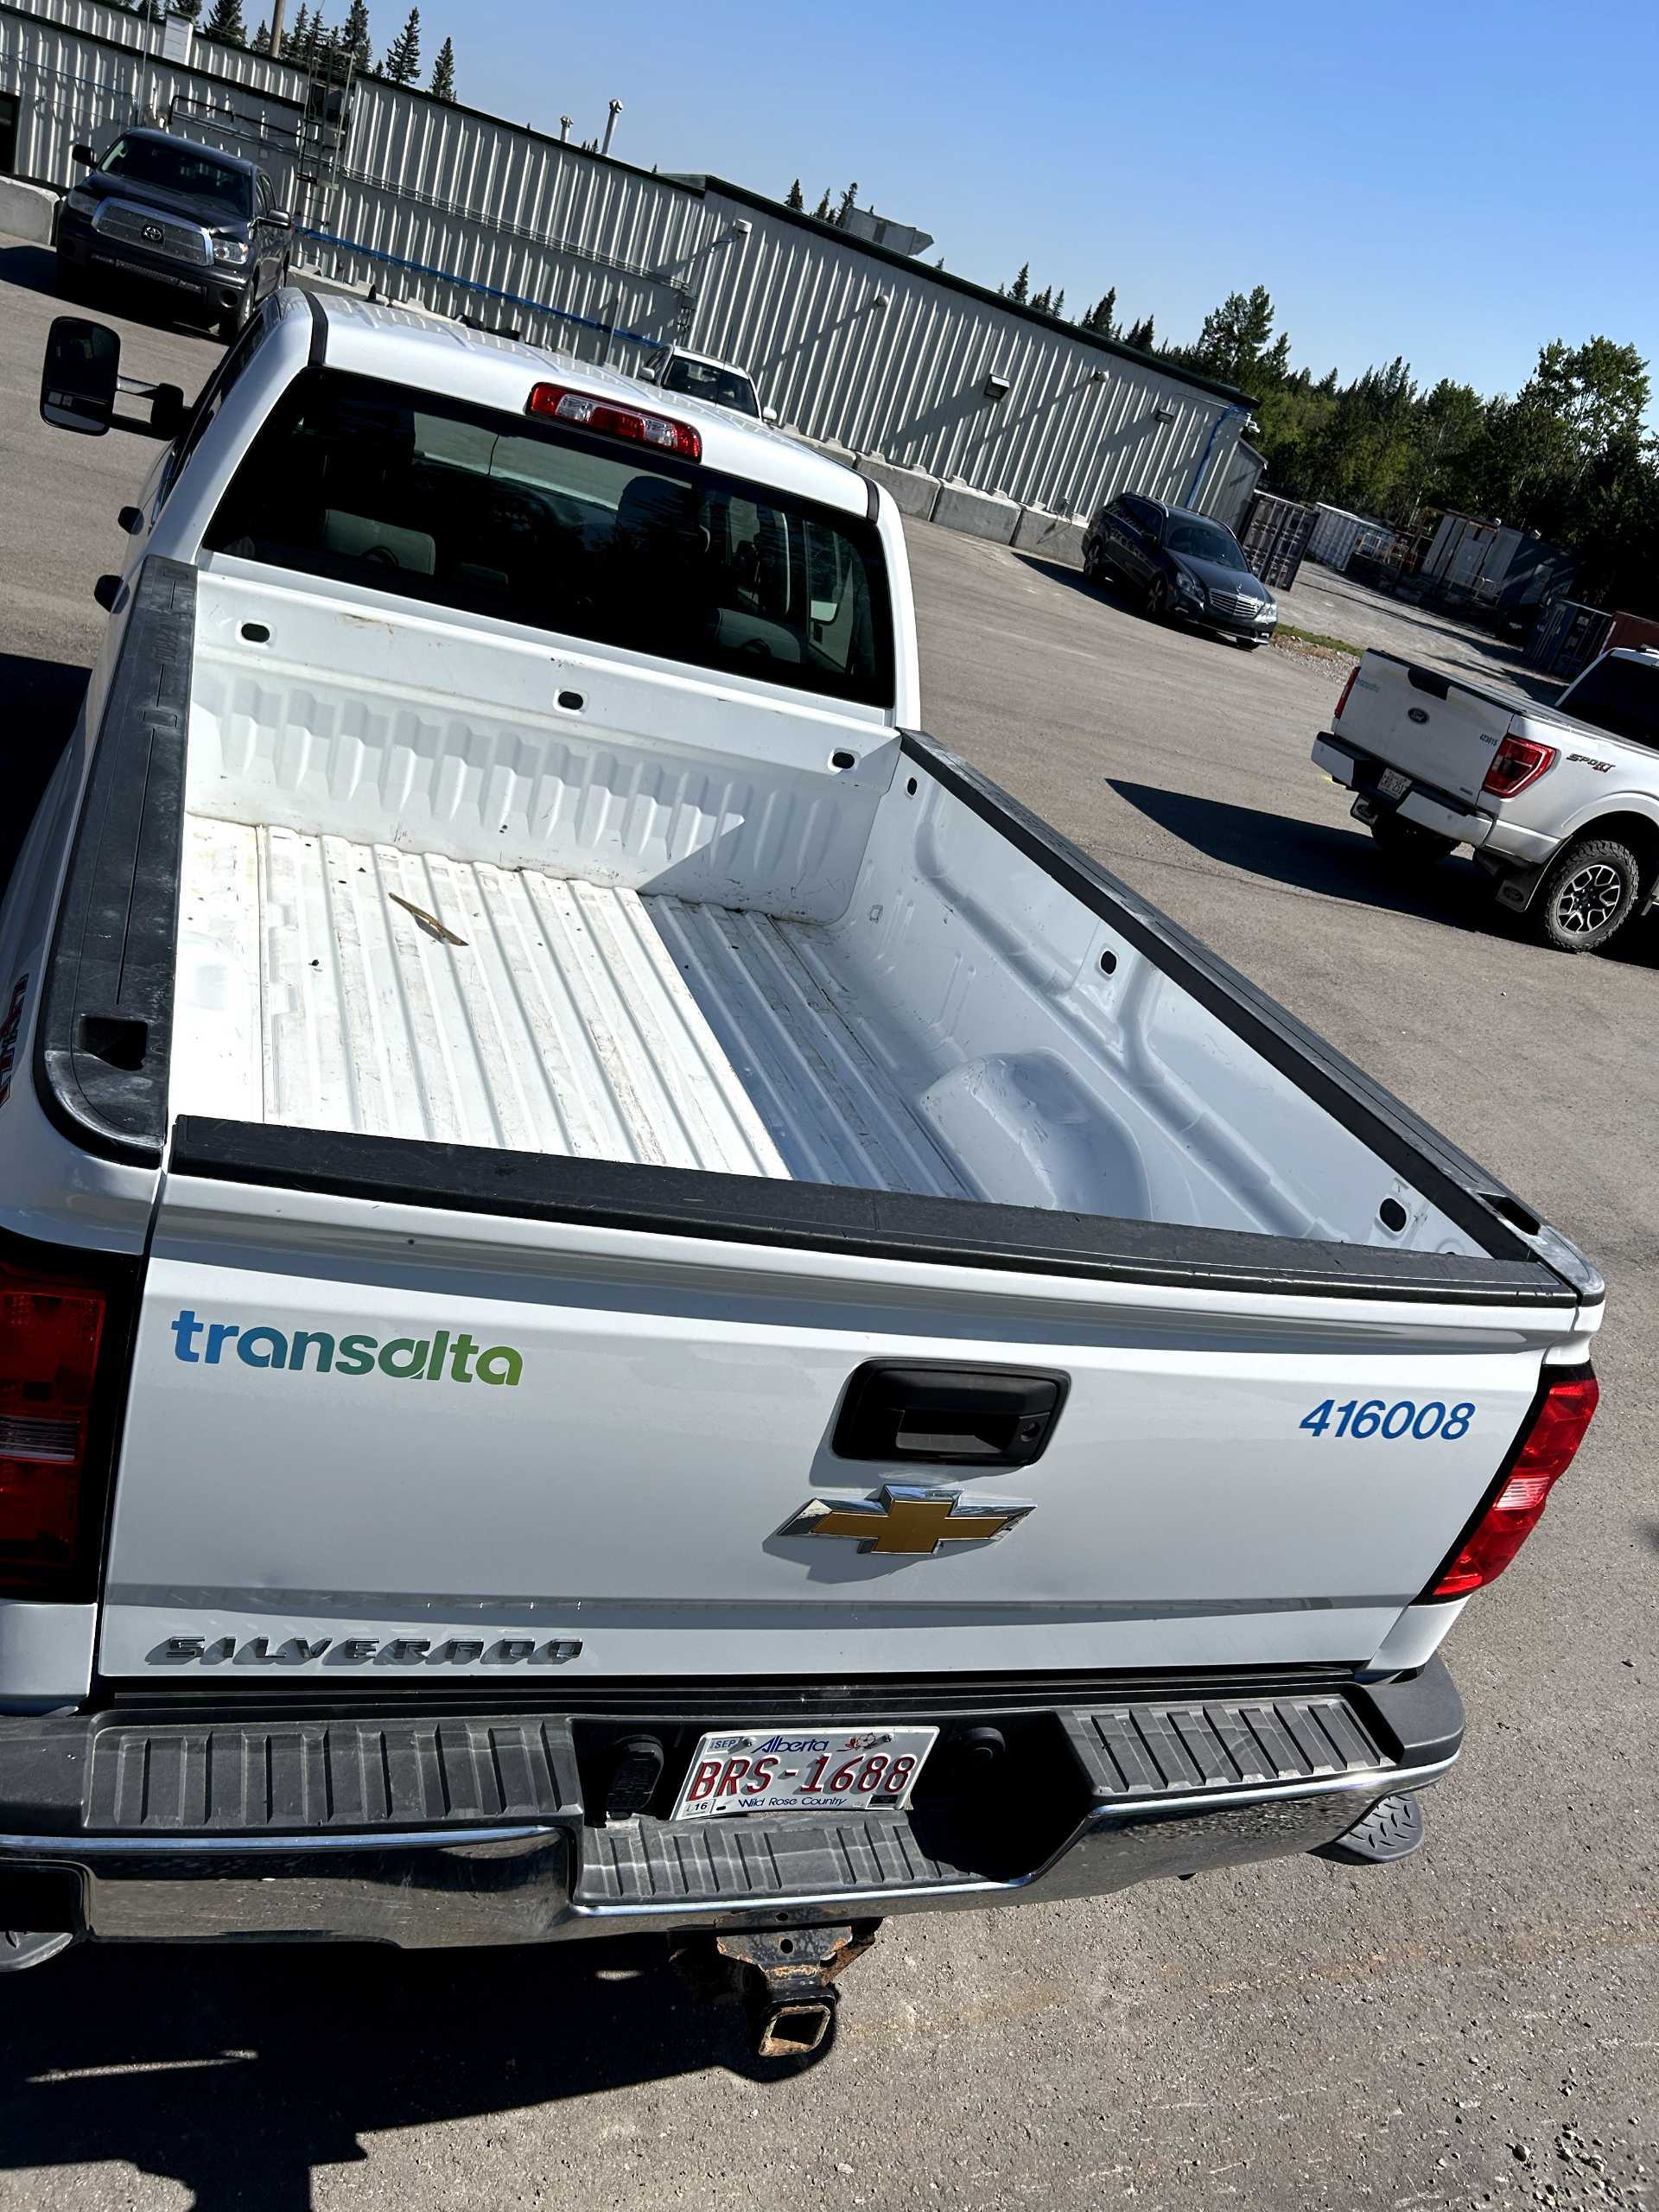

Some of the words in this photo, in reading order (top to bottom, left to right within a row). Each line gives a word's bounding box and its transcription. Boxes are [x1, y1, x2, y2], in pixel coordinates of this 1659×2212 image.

[171, 1310, 524, 1386] transalta
[1299, 1399, 1476, 1440] 416008
[165, 1636, 583, 1660] SILVERADO
[714, 1739, 736, 1749] SEP
[751, 1735, 830, 1753] Alberta
[695, 1802, 709, 1811] 16
[738, 1797, 766, 1808] Wild
[769, 1796, 798, 1806] Rose
[802, 1796, 848, 1807] Country
